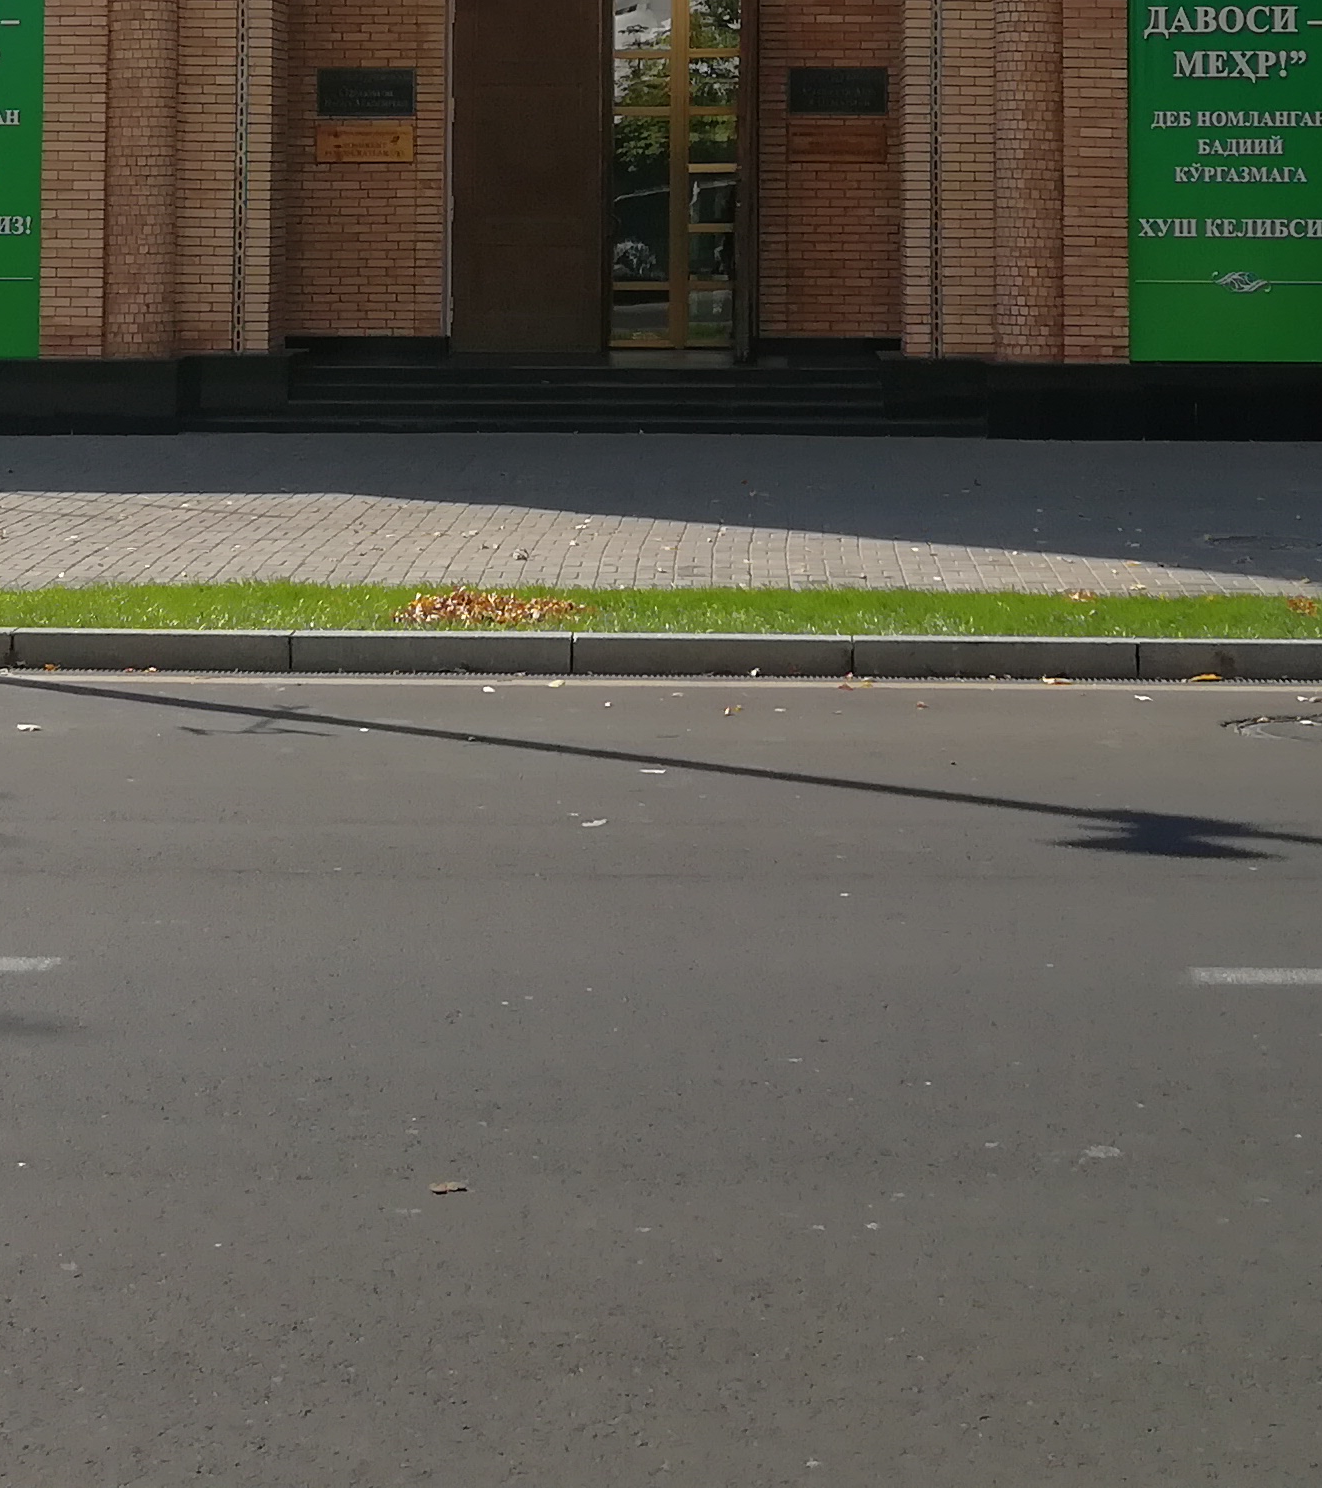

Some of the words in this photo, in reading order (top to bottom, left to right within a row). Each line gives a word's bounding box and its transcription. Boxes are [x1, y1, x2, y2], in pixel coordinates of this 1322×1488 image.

[1142, 6, 1299, 39] ДАВОСИ
[1150, 111, 1192, 130] ДЕБ
[1196, 134, 1284, 157] БАДИИЙ
[1174, 163, 1308, 183] КЎРГАЗМАГА
[1137, 218, 1198, 238] ХУШ
